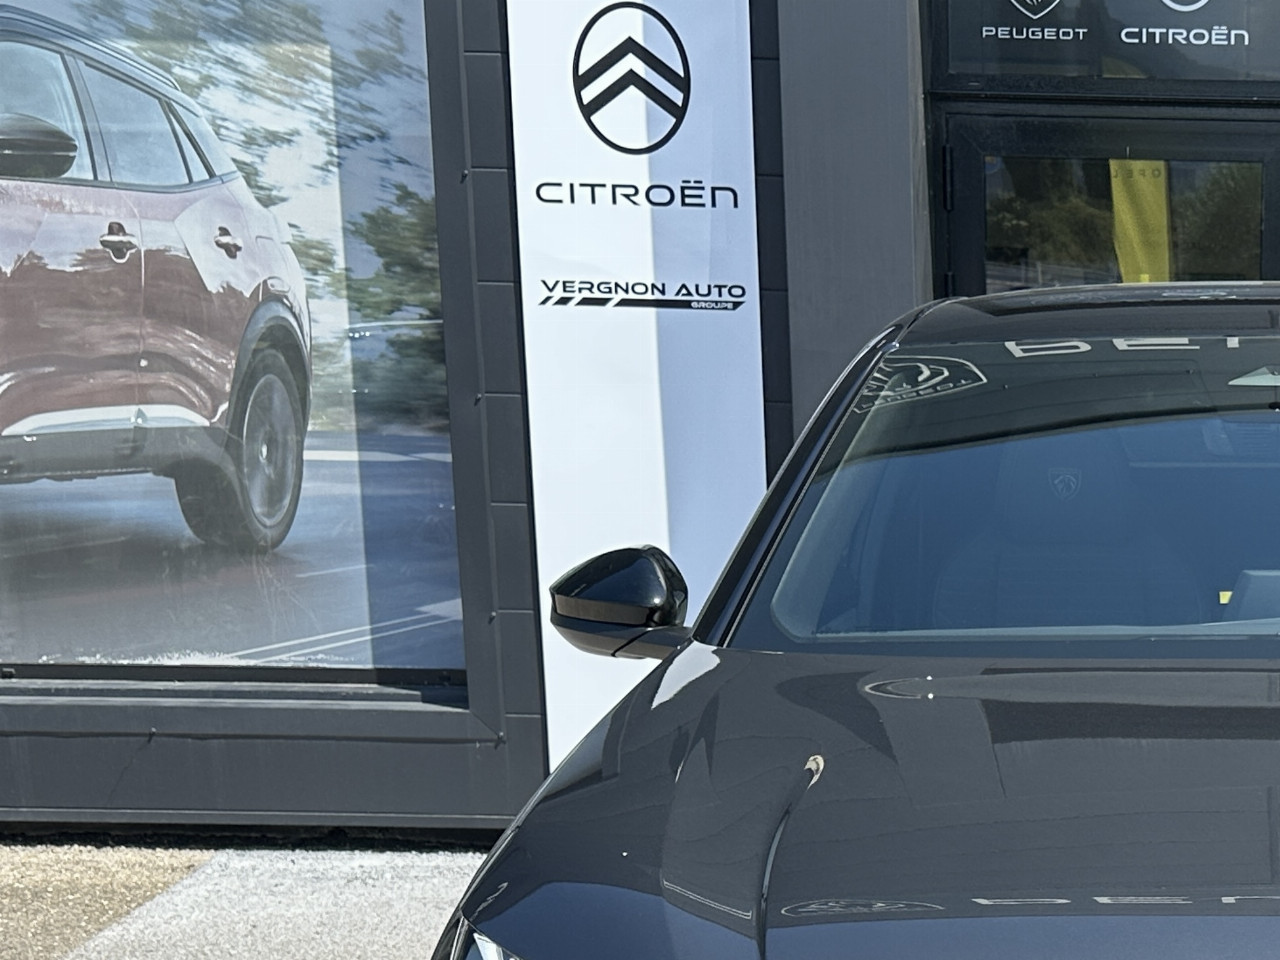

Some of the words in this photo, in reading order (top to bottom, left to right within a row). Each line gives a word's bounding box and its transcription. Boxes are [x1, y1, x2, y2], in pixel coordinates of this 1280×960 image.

[982, 26, 1088, 41] PEUGEOT
[541, 279, 666, 297] VERGNON
[674, 283, 746, 299] AUTO
[690, 300, 734, 310] GROUPE
